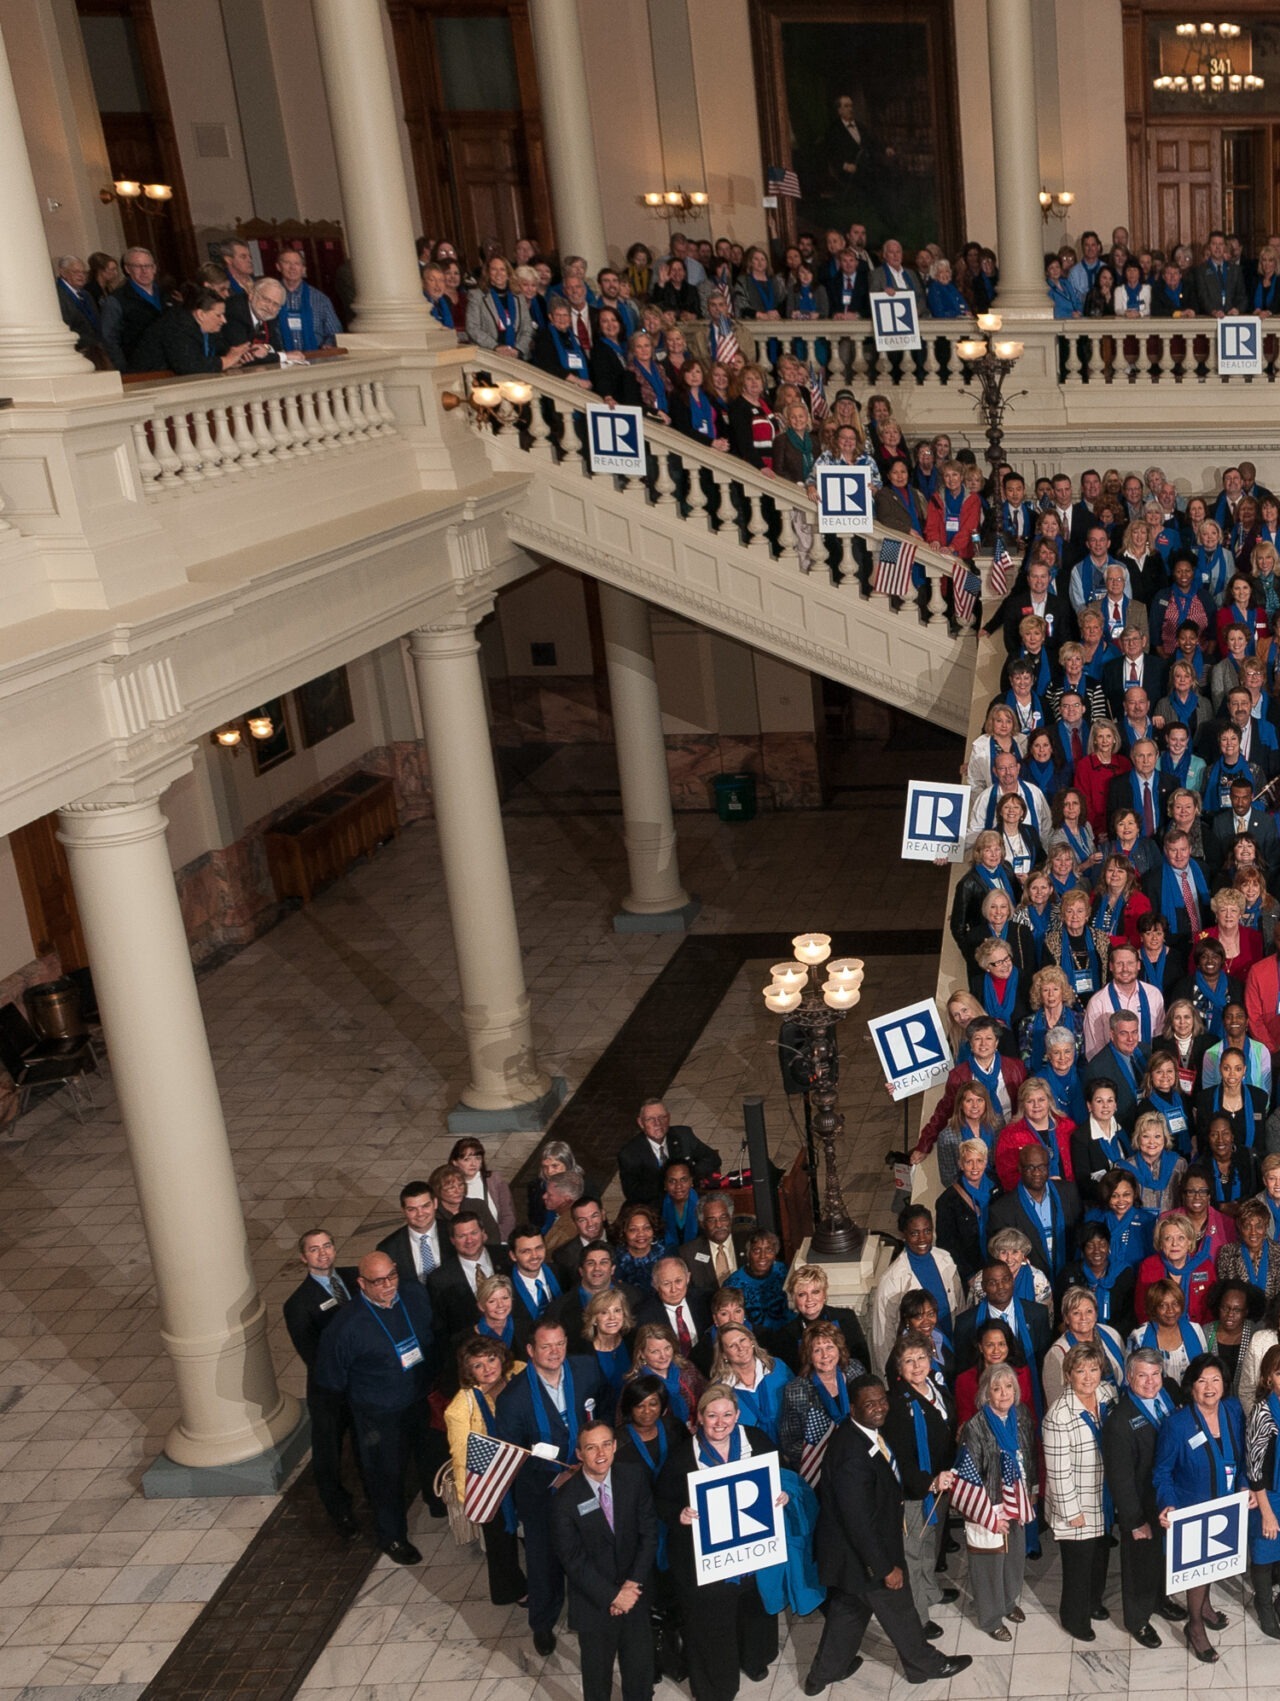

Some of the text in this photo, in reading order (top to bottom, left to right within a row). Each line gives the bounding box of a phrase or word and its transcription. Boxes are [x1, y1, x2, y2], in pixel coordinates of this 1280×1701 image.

[1210, 59, 1231, 75] 341
[878, 336, 916, 345] REALTOR
[594, 456, 641, 468] REALTOR
[822, 517, 868, 526] REALTOR
[906, 842, 959, 854] REALTOR
[894, 1062, 949, 1090] REALTOR
[702, 1540, 777, 1571] REALTOR
[1172, 1558, 1239, 1584] REALTOR
